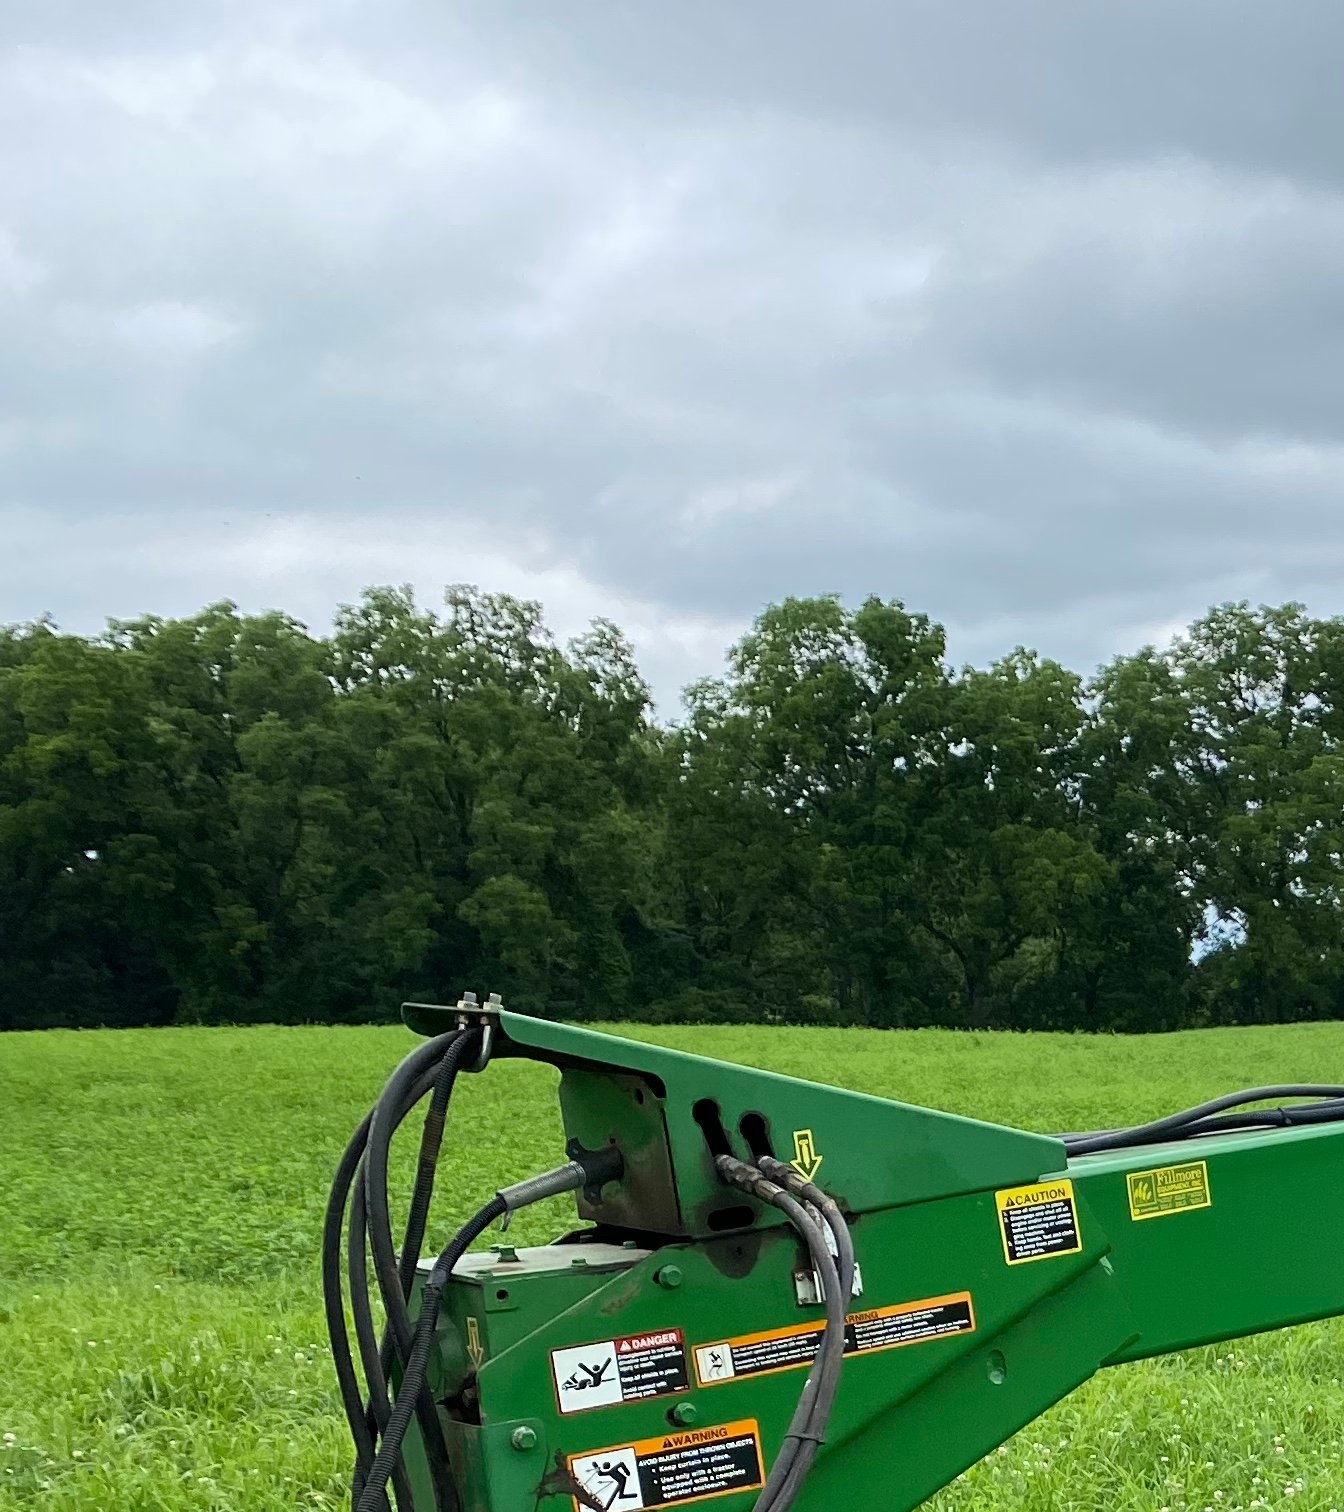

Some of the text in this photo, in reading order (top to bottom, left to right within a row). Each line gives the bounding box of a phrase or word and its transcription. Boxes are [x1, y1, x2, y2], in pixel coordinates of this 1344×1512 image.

[1156, 1169, 1202, 1187] Fillmore
[1015, 1187, 1066, 1206] CAUTION
[844, 1311, 879, 1324] RNING
[632, 1332, 677, 1350] DANGER
[673, 1427, 728, 1447] WARNING
[638, 1438, 753, 1466] AVOID INJURY FROM THROWN OBJECTS
[659, 1464, 676, 1472] Keep
[710, 1453, 730, 1462] place.
[691, 1469, 706, 1477] with
[712, 1463, 735, 1472] tractor
[661, 1479, 693, 1491] equipped
[715, 1469, 745, 1479] complete
[663, 1480, 728, 1498] operator enclosure.
